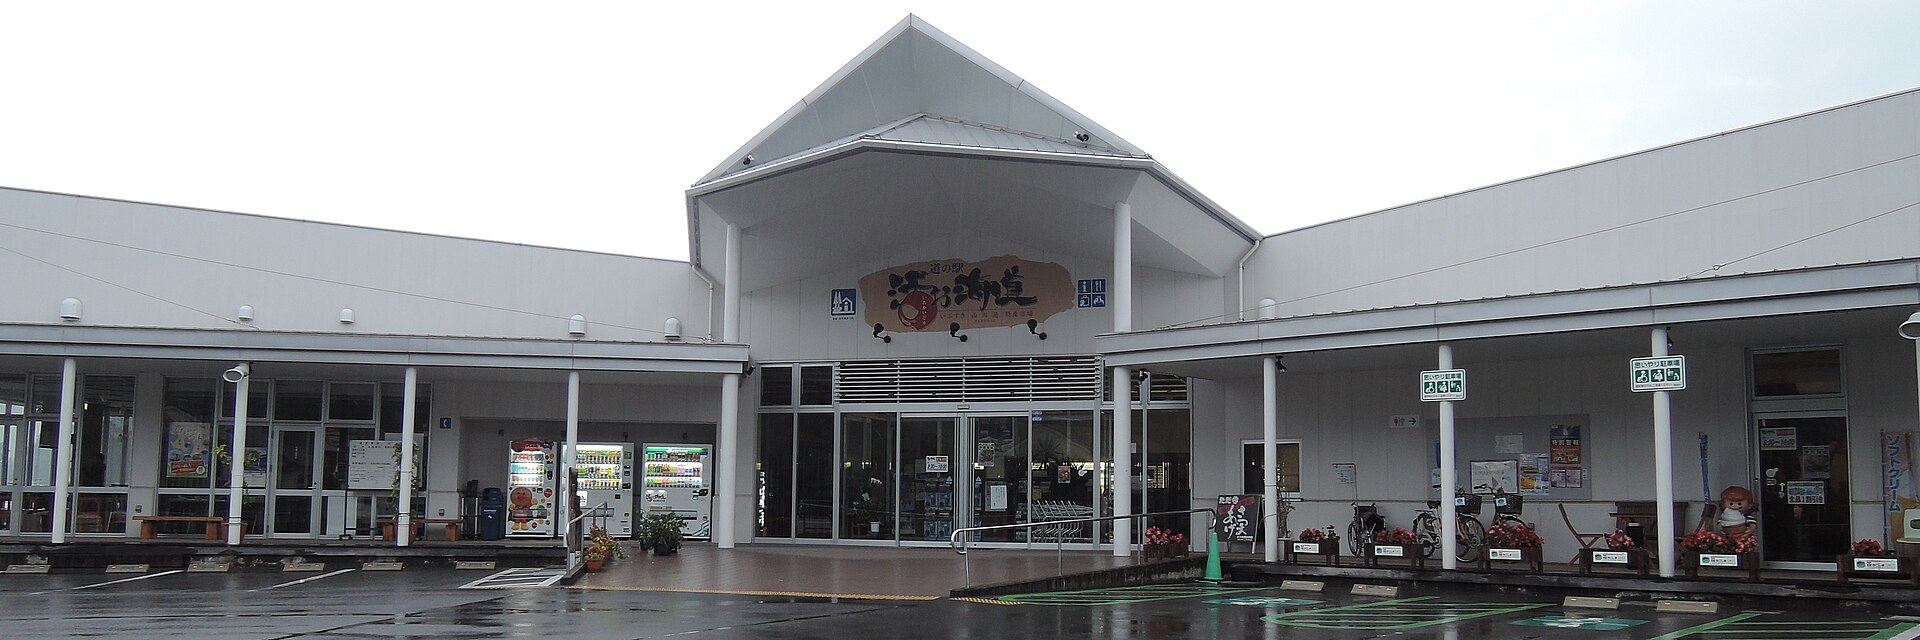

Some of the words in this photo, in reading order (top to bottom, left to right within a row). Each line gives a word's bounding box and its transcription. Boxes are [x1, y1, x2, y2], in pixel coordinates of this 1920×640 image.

[929, 262, 964, 274] 道の駅
[1634, 359, 1680, 369] 思いやり駐車場
[1887, 435, 1901, 511] ソフトクリーム
